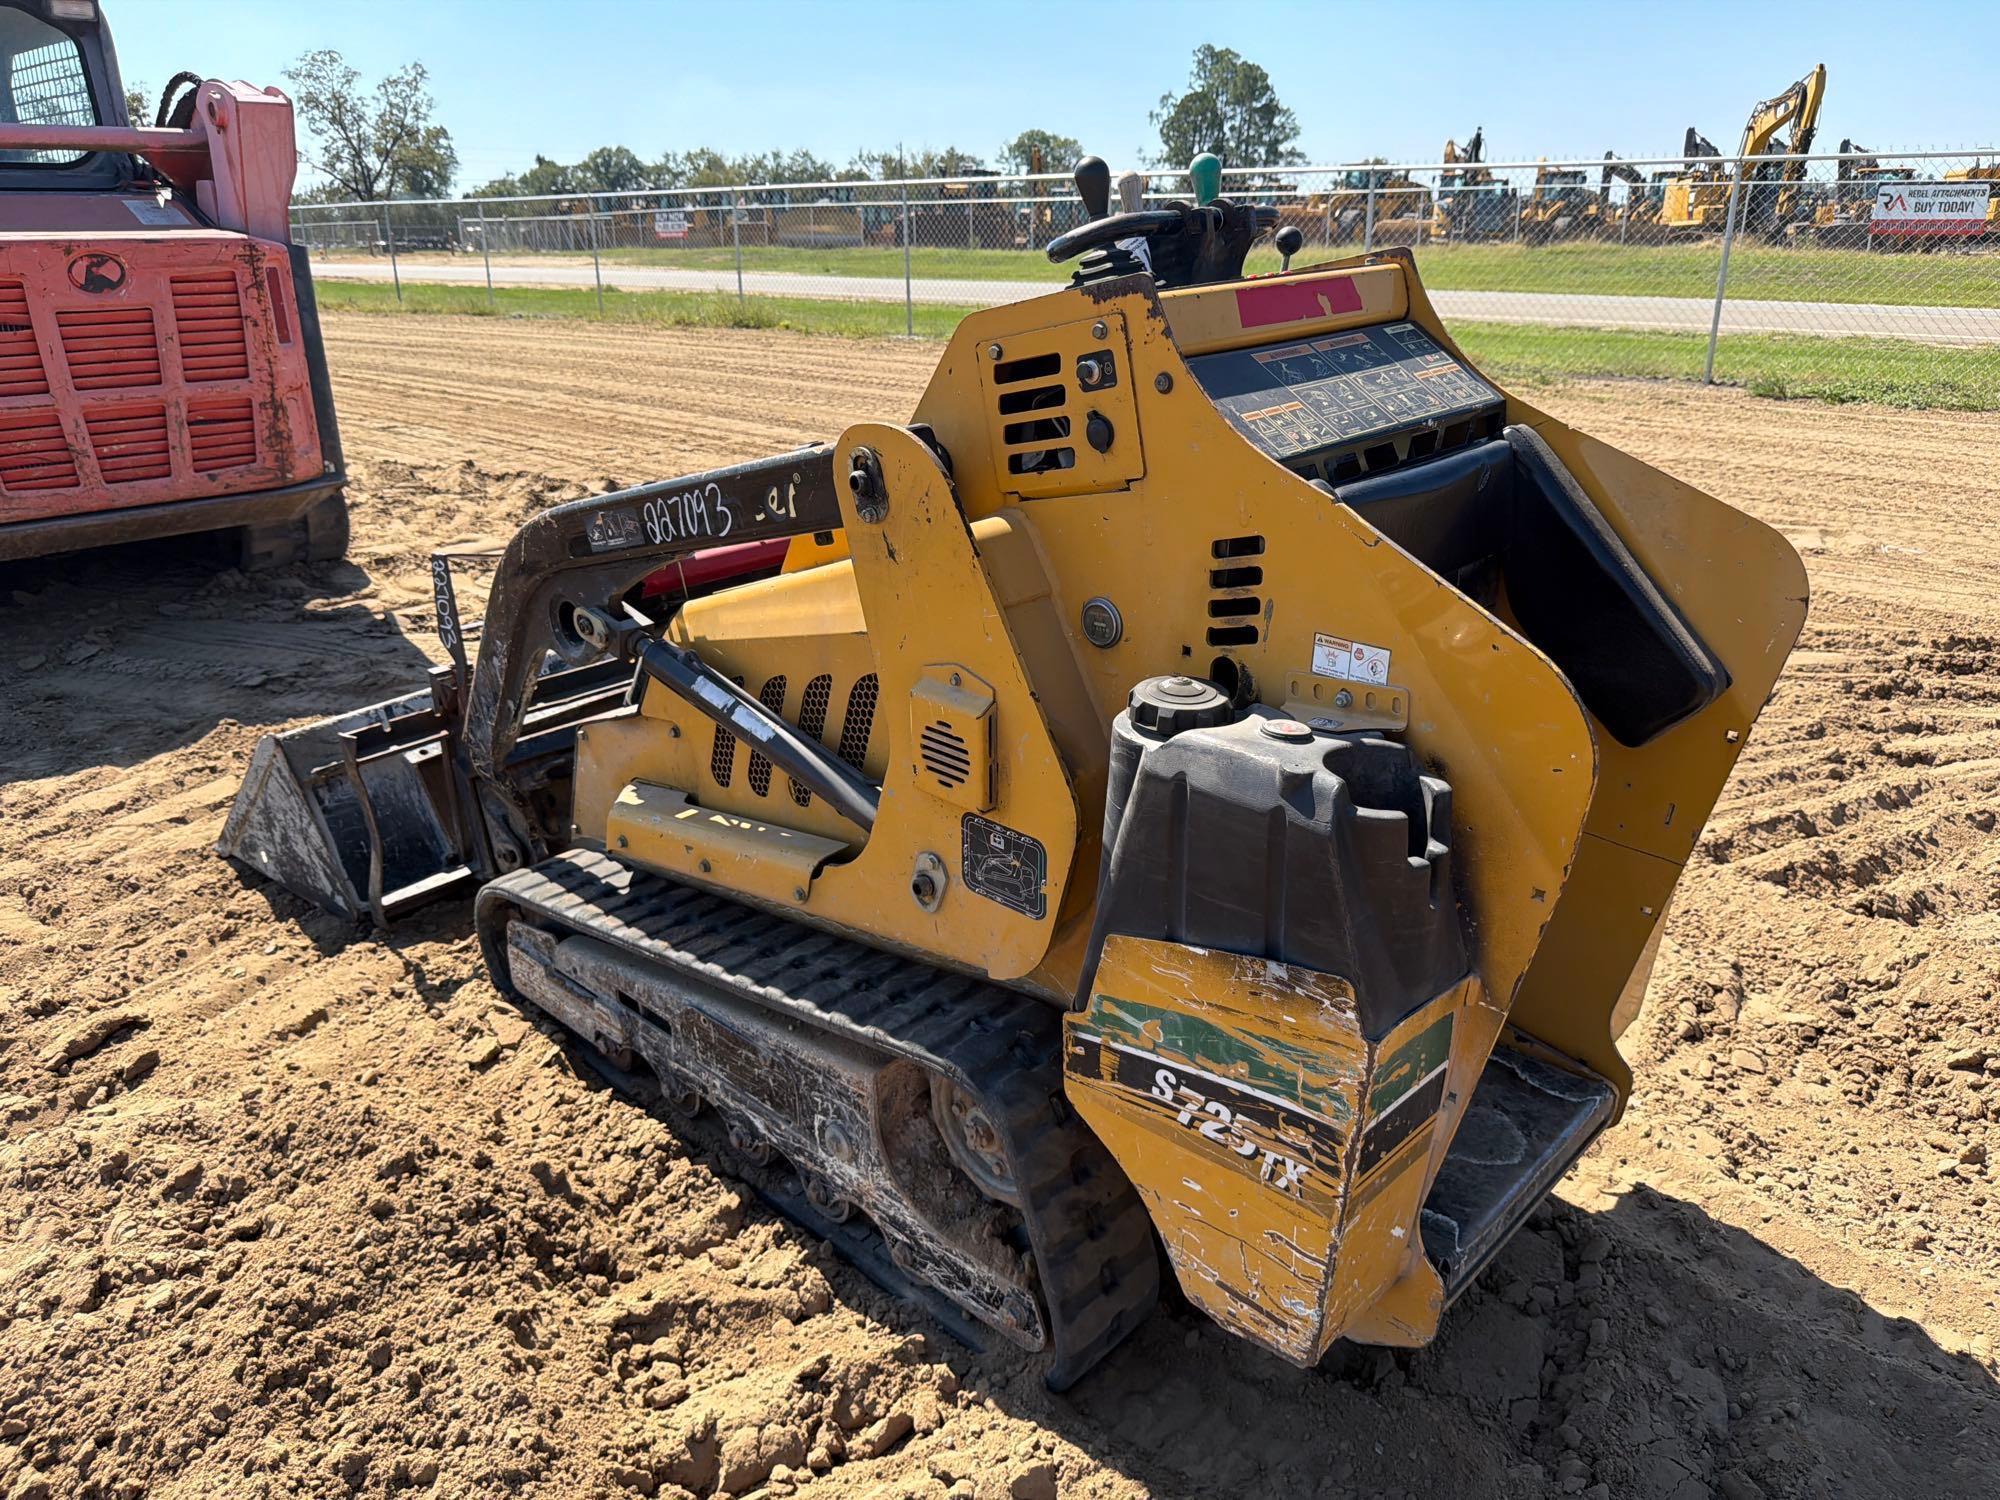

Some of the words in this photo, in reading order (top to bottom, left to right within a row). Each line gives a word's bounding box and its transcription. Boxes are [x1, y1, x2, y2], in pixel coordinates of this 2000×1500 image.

[1908, 189, 1929, 198] REBEL
[1931, 188, 1988, 198] ATTACHMENTS
[1914, 201, 1935, 213] BUY
[1937, 201, 1975, 213] TODAY!
[643, 482, 732, 545] 227093
[432, 559, 457, 649] 227093
[1324, 638, 1349, 649] WARNING
